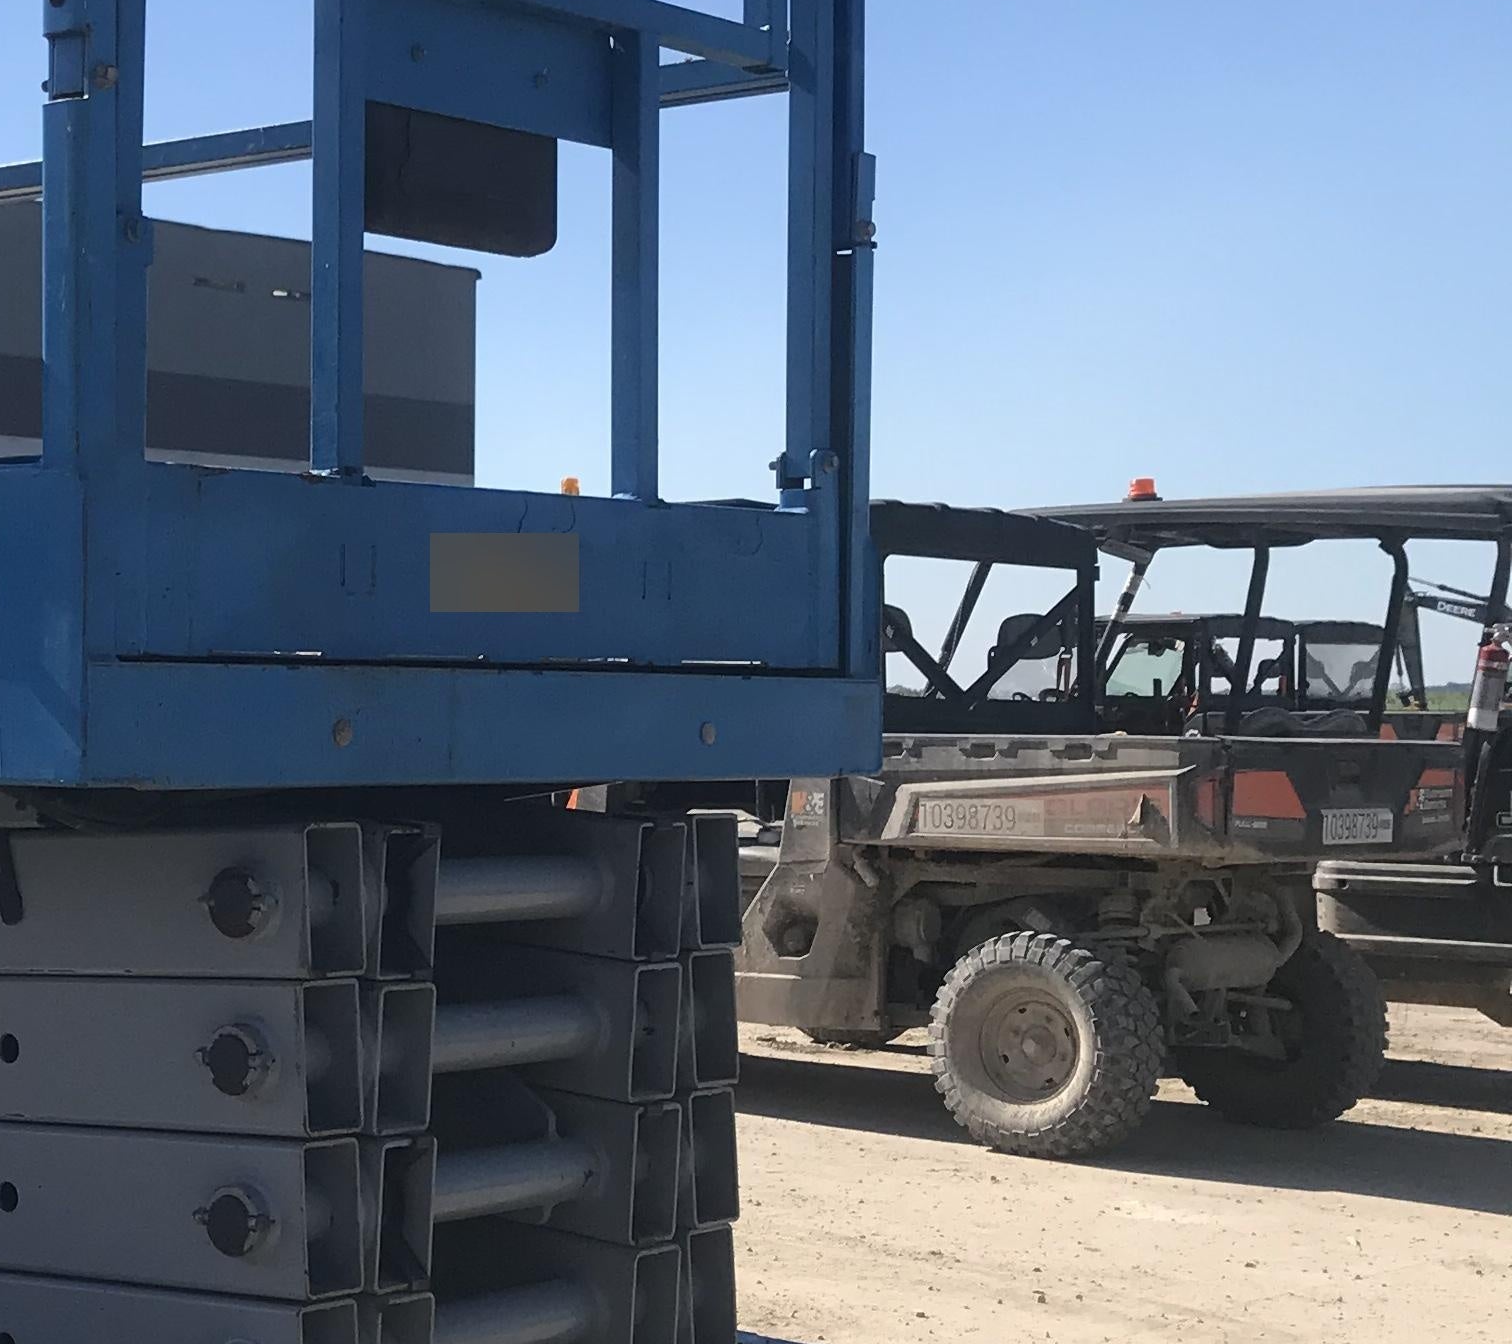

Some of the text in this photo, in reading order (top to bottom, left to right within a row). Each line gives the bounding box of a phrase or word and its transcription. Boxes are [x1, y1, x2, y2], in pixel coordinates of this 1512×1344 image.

[1437, 601, 1476, 617] DEERE
[920, 803, 1016, 830] 10398739
[1324, 812, 1378, 840] 10398739
